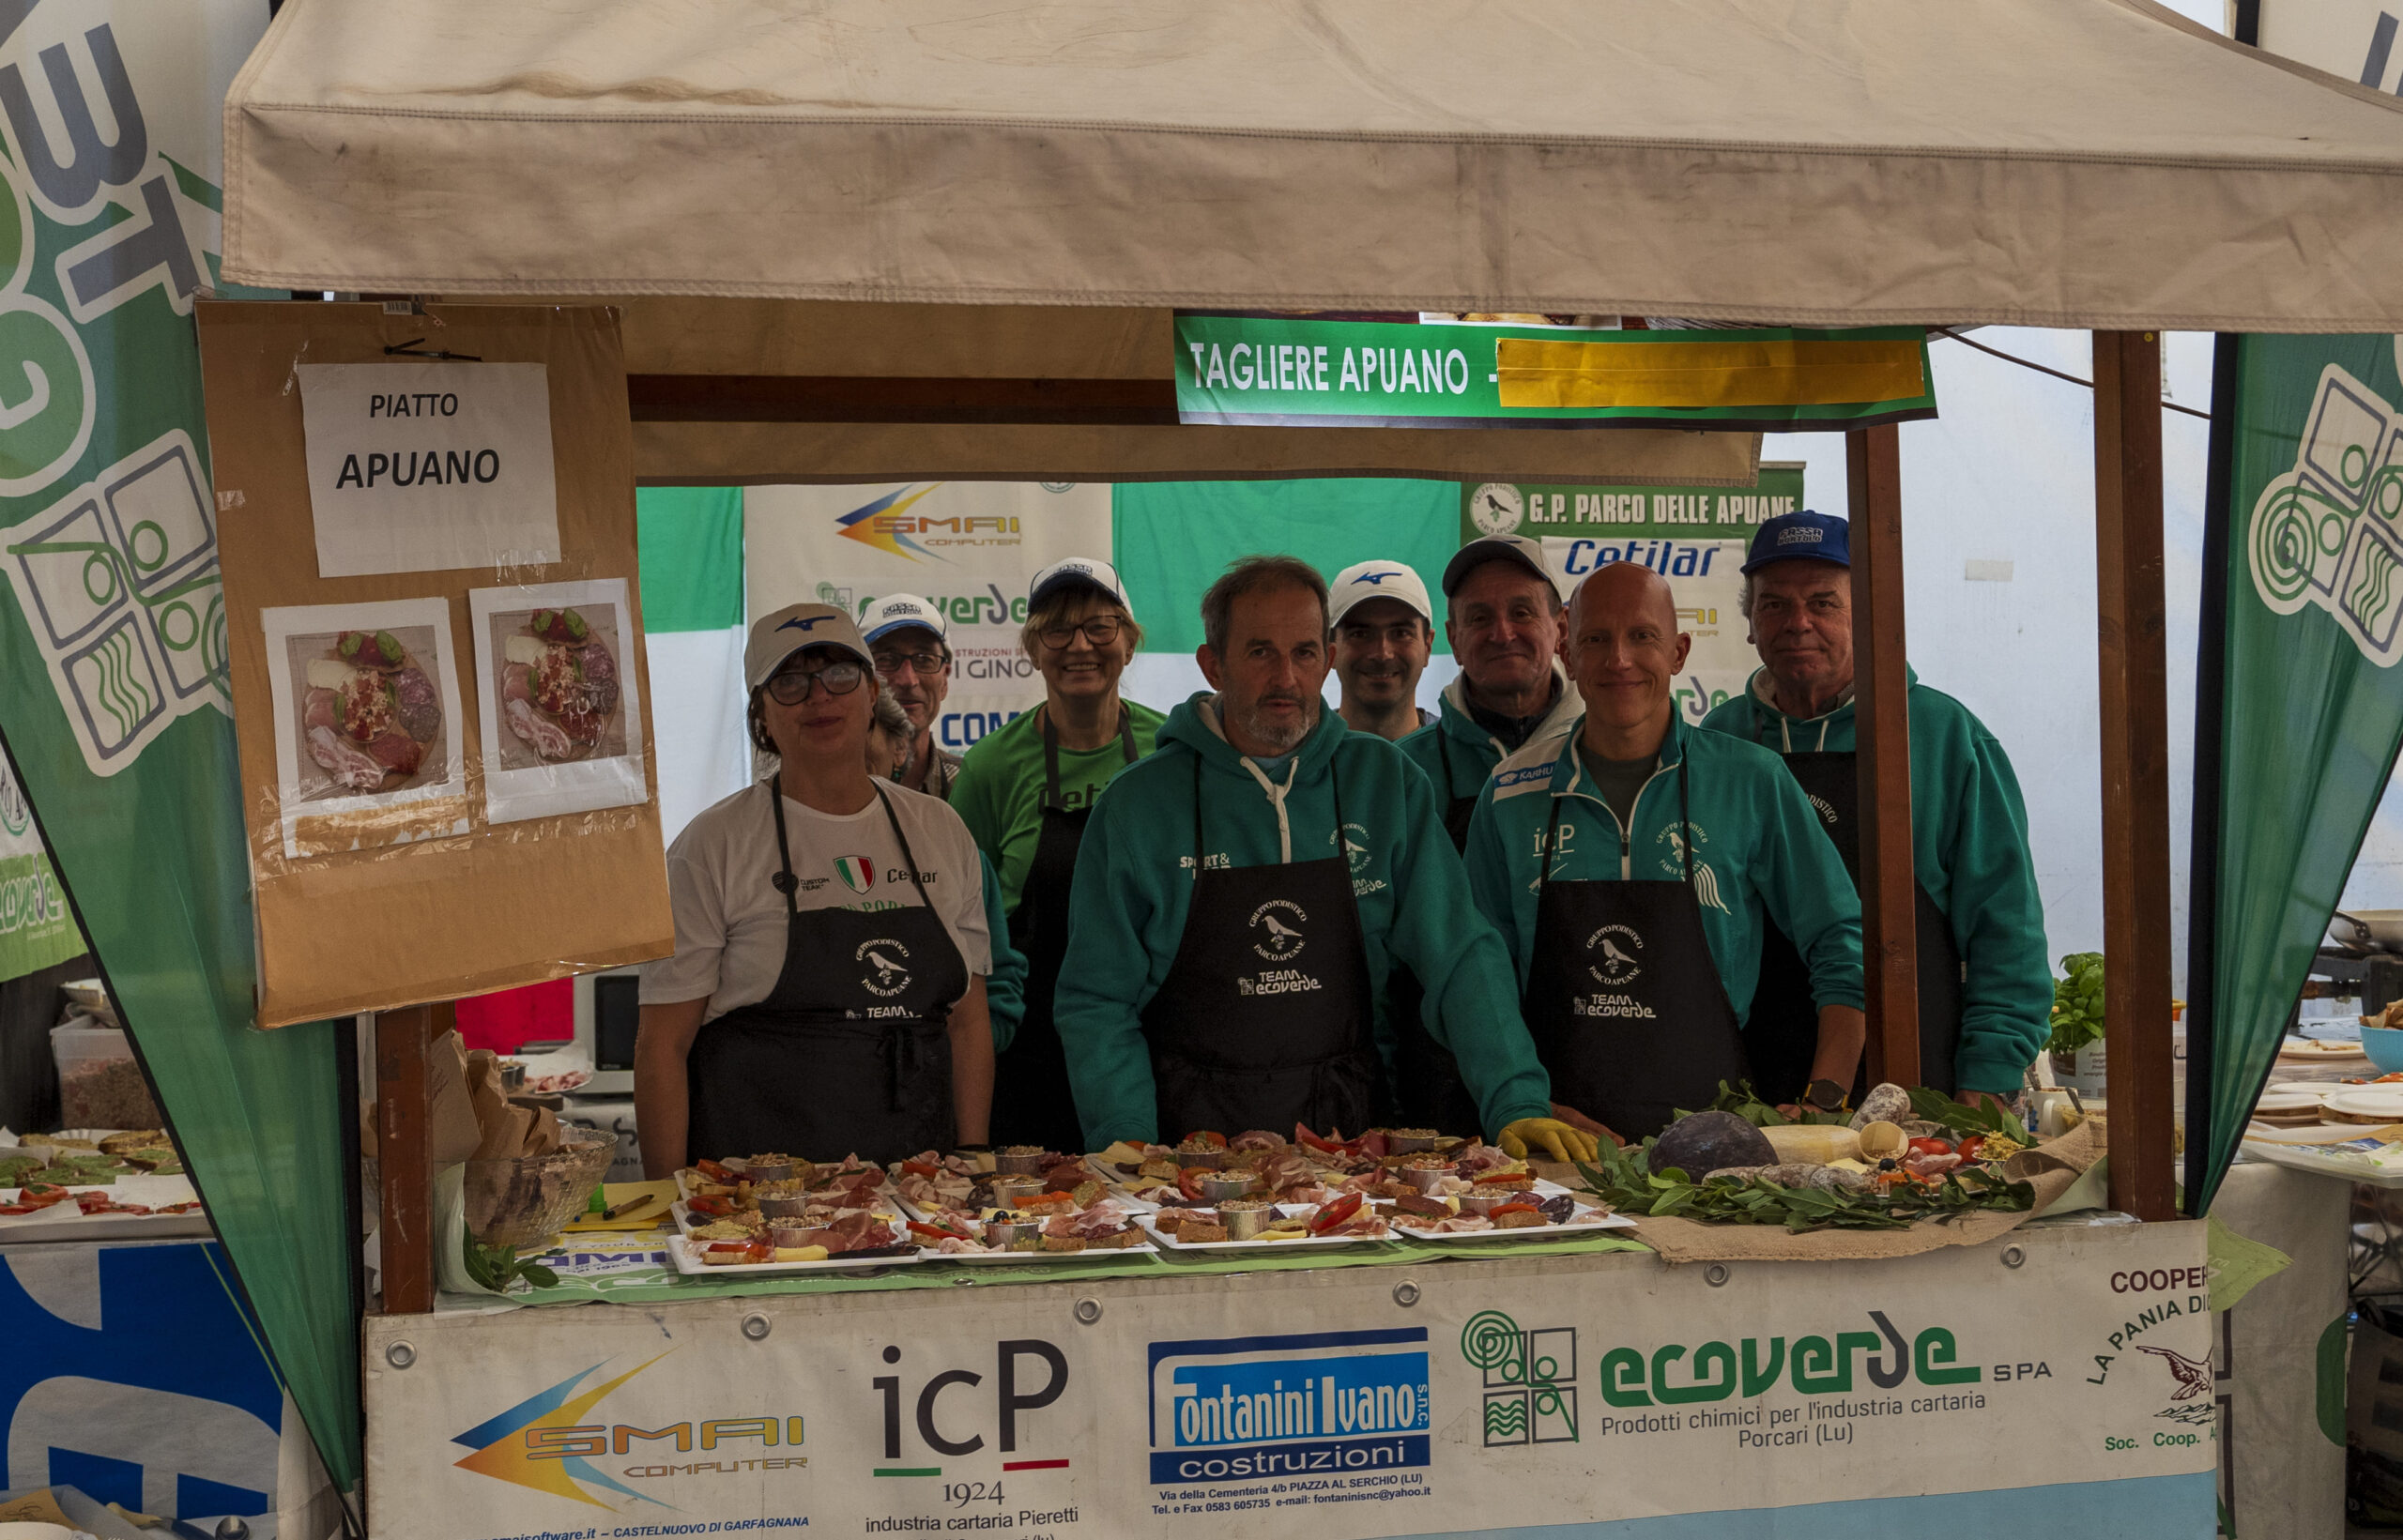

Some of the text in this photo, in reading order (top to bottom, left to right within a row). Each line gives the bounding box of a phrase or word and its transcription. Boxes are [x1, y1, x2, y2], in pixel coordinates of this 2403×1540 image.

[1189, 342, 1470, 395] TAGLIERE APUANO
[369, 392, 459, 419] PIATTO
[335, 448, 501, 490] APUANO
[1529, 494, 1567, 524] G.P.
[1575, 494, 1645, 524] PARCO
[1653, 495, 1709, 525] DELLE
[873, 517, 1020, 533] SMAI
[968, 659, 1033, 679] GINO
[1519, 766, 1554, 781] KARHU
[1179, 854, 1219, 869] SPRT
[1248, 900, 1307, 927] GRUPPO PODISTICO
[1586, 924, 1644, 949] GRUPPO PODISTICO
[1253, 939, 1306, 962] PARCO APUANE
[1255, 974, 1323, 995] ecoverde
[1259, 969, 1300, 983] TEAM
[1589, 965, 1642, 985] PARCO APUANE
[866, 1006, 907, 1018] TEAM
[1587, 1001, 1657, 1018] ecoverde
[1591, 995, 1633, 1006] TEAM
[2087, 1352, 2115, 1385] LA
[2107, 1300, 2182, 1351] PANIA
[1599, 1310, 2053, 1408] ecoverde SPA
[873, 1339, 1068, 1458] icP
[1155, 1366, 1314, 1444] Fontanini
[1322, 1376, 1416, 1435] Ivano
[1601, 1391, 1986, 1436] Prodotti chimici per l'industria cartaria
[525, 1415, 804, 1461] SMAI
[1739, 1422, 1853, 1448] Porcari (Lu)
[2105, 1436, 2139, 1452] Soc.
[2153, 1431, 2201, 1449] Coop.
[622, 1456, 808, 1479] COMPUTER
[1179, 1440, 1405, 1478] costruzioni
[941, 1480, 1005, 1509] 1924
[1159, 1473, 1423, 1501] Via della Cementeria 4/b PIAZZA AL SERCHIO (LU)
[1152, 1504, 1171, 1515] Tel.
[1183, 1503, 1203, 1514] Fax
[1205, 1502, 1232, 1513] 0583
[1233, 1499, 1271, 1510] 605735
[1276, 1496, 1311, 1507] e-mail:
[1314, 1487, 1431, 1504] fontaninisnc@yahoo.it
[613, 1523, 706, 1538] CASTELNUOVO
[709, 1521, 722, 1532] DI
[724, 1517, 809, 1532] GARFAGNANA
[865, 1507, 1079, 1532] industria cartaria Pieretti
